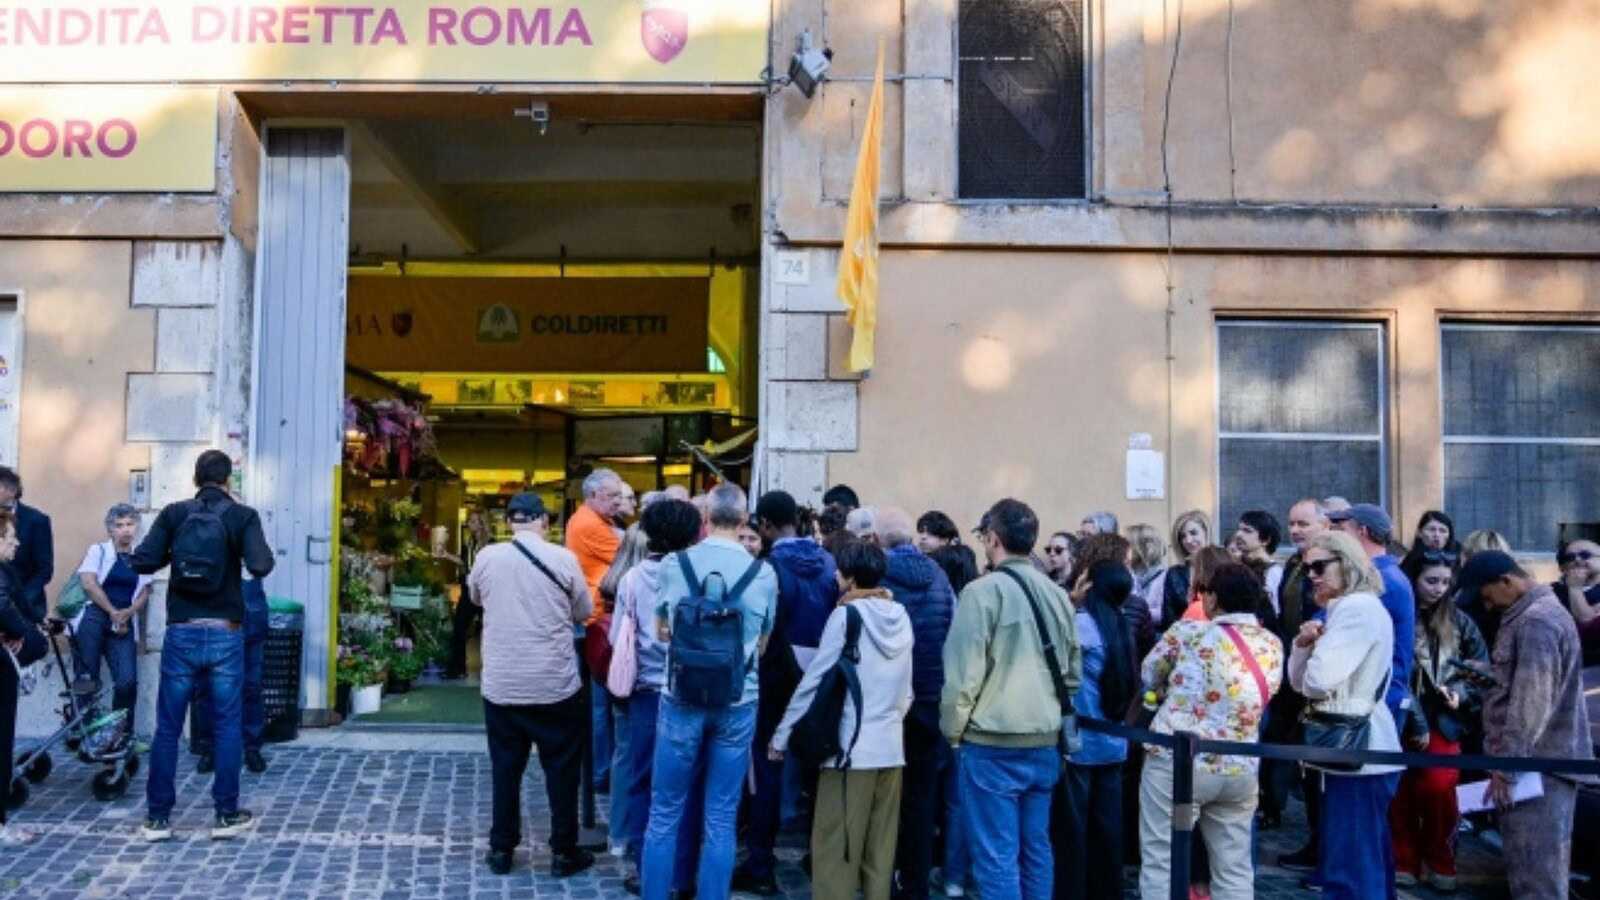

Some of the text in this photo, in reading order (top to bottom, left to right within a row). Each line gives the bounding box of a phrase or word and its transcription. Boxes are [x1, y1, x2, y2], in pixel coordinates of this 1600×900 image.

[191, 6, 409, 45] DIRETTA
[427, 5, 593, 47] ROMA
[783, 259, 804, 275] 74
[531, 313, 668, 336] COLDIRETTI
